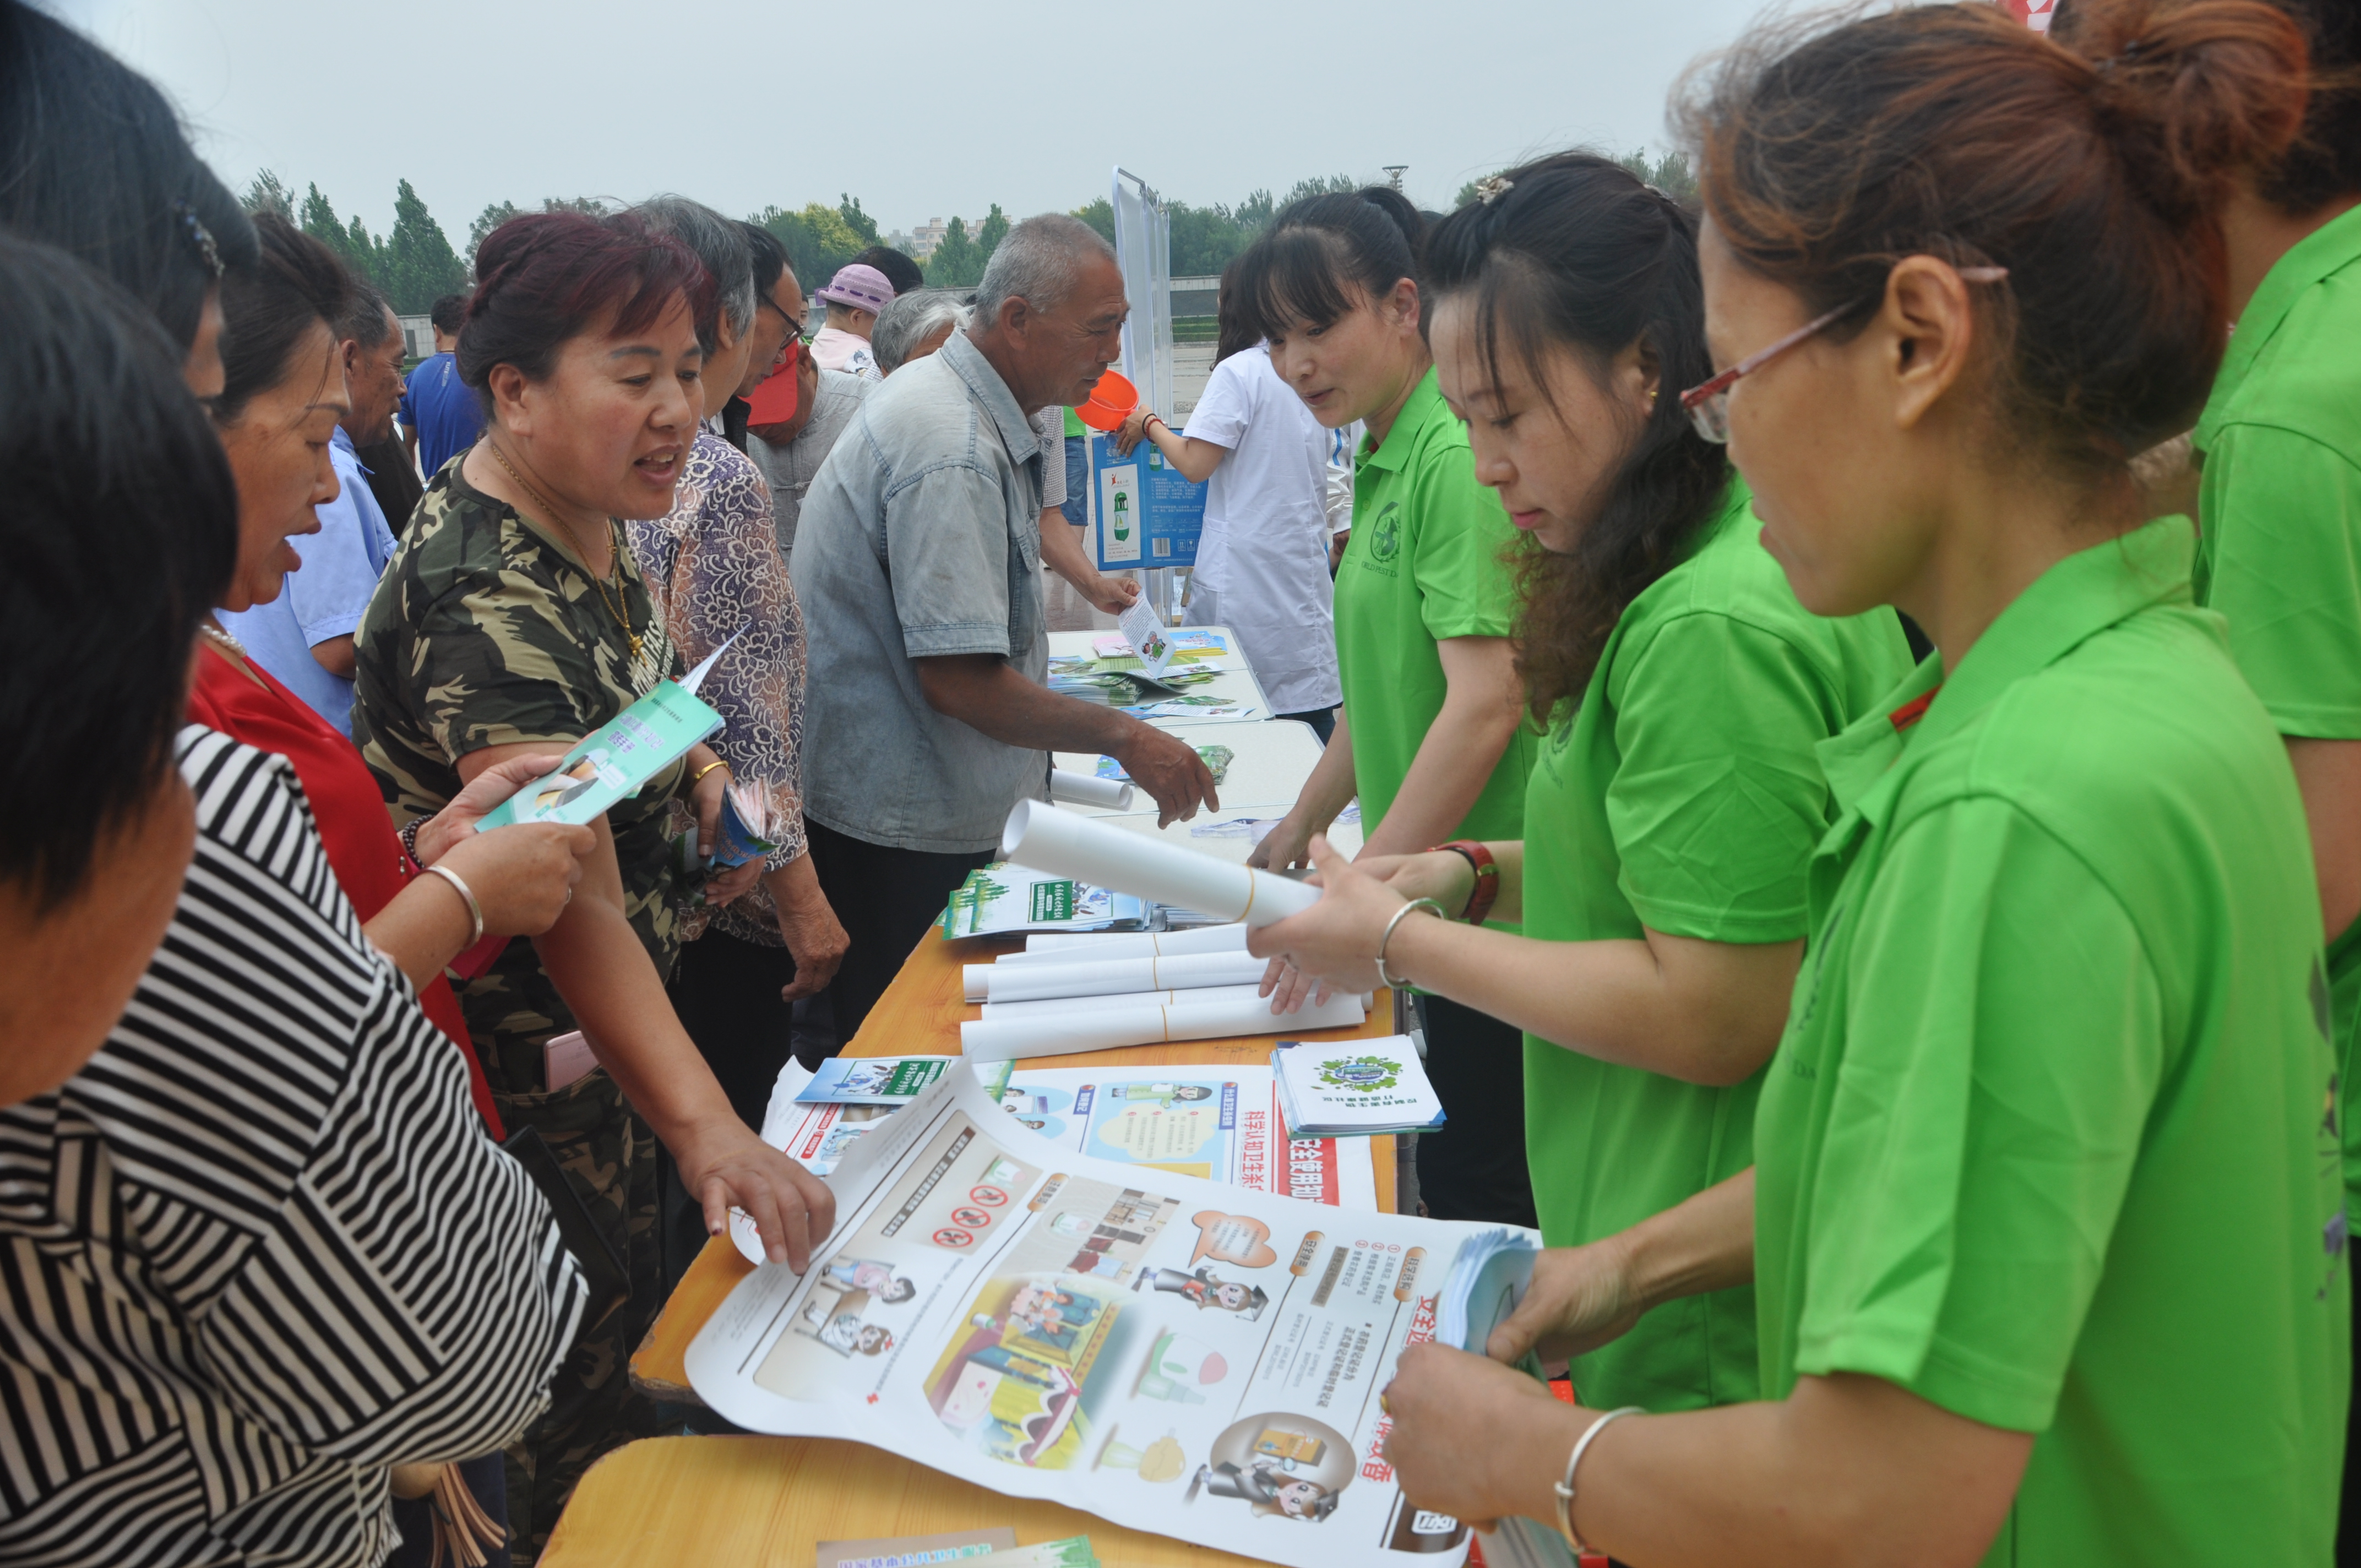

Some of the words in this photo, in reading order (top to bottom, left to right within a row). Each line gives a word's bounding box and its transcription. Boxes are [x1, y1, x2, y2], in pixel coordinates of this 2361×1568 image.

[1375, 565, 1388, 576] PEST
[1221, 1088, 1234, 1126] 什么是卫生杀虫剂
[1345, 1097, 1417, 1108] 控制有害生物
[1288, 1139, 1325, 1203] 安全使用知
[1294, 1239, 1318, 1268] 安全使用
[1341, 1250, 1363, 1287] 查看农药登记证
[1399, 1257, 1420, 1290] 科学选购
[1316, 1326, 1356, 1408] 正式登记证和临时登记证
[1342, 1330, 1371, 1381] 农药登记证分为
